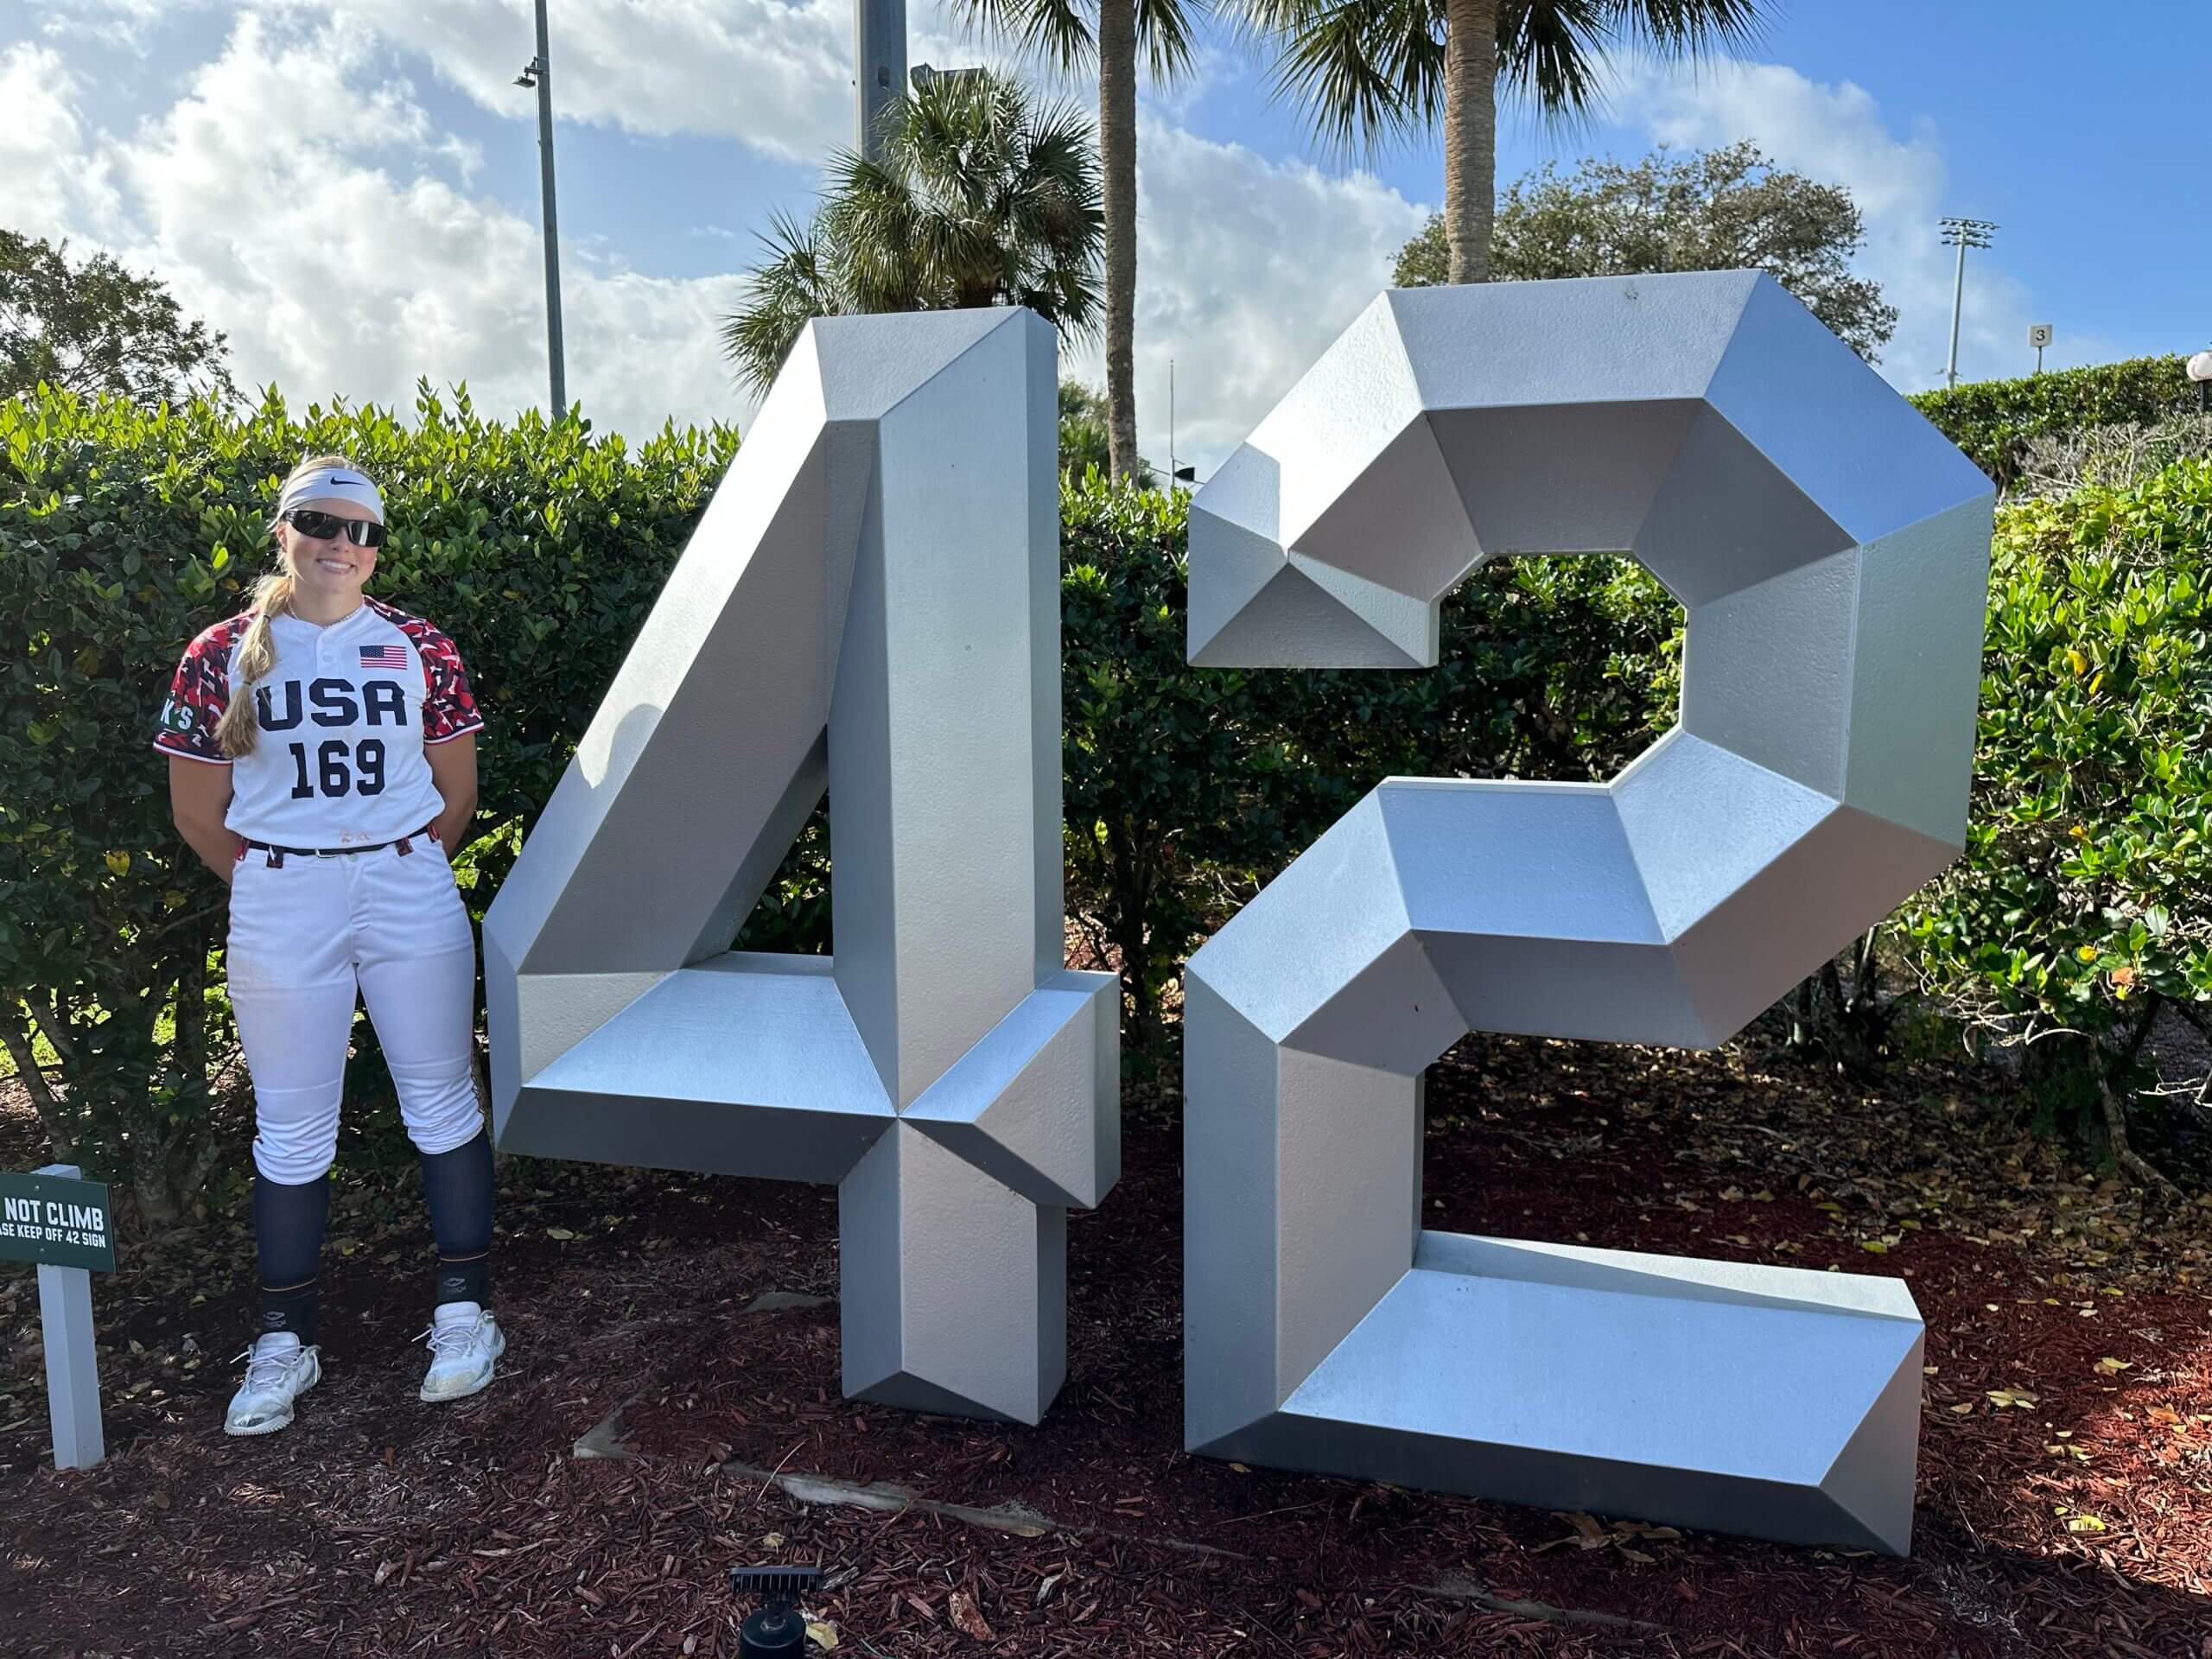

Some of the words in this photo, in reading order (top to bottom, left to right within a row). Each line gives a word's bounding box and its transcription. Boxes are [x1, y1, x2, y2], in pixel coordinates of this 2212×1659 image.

[2035, 329, 2046, 341] 3
[256, 677, 408, 732] USA
[289, 739, 385, 800] 169
[482, 267, 1996, 1558] 42
[4, 1197, 41, 1224] NOT
[46, 1201, 105, 1231] CLIMB
[17, 1224, 42, 1240] KEEP
[45, 1227, 63, 1243] OFF
[66, 1230, 80, 1244] 42
[82, 1231, 106, 1249] SIGN
